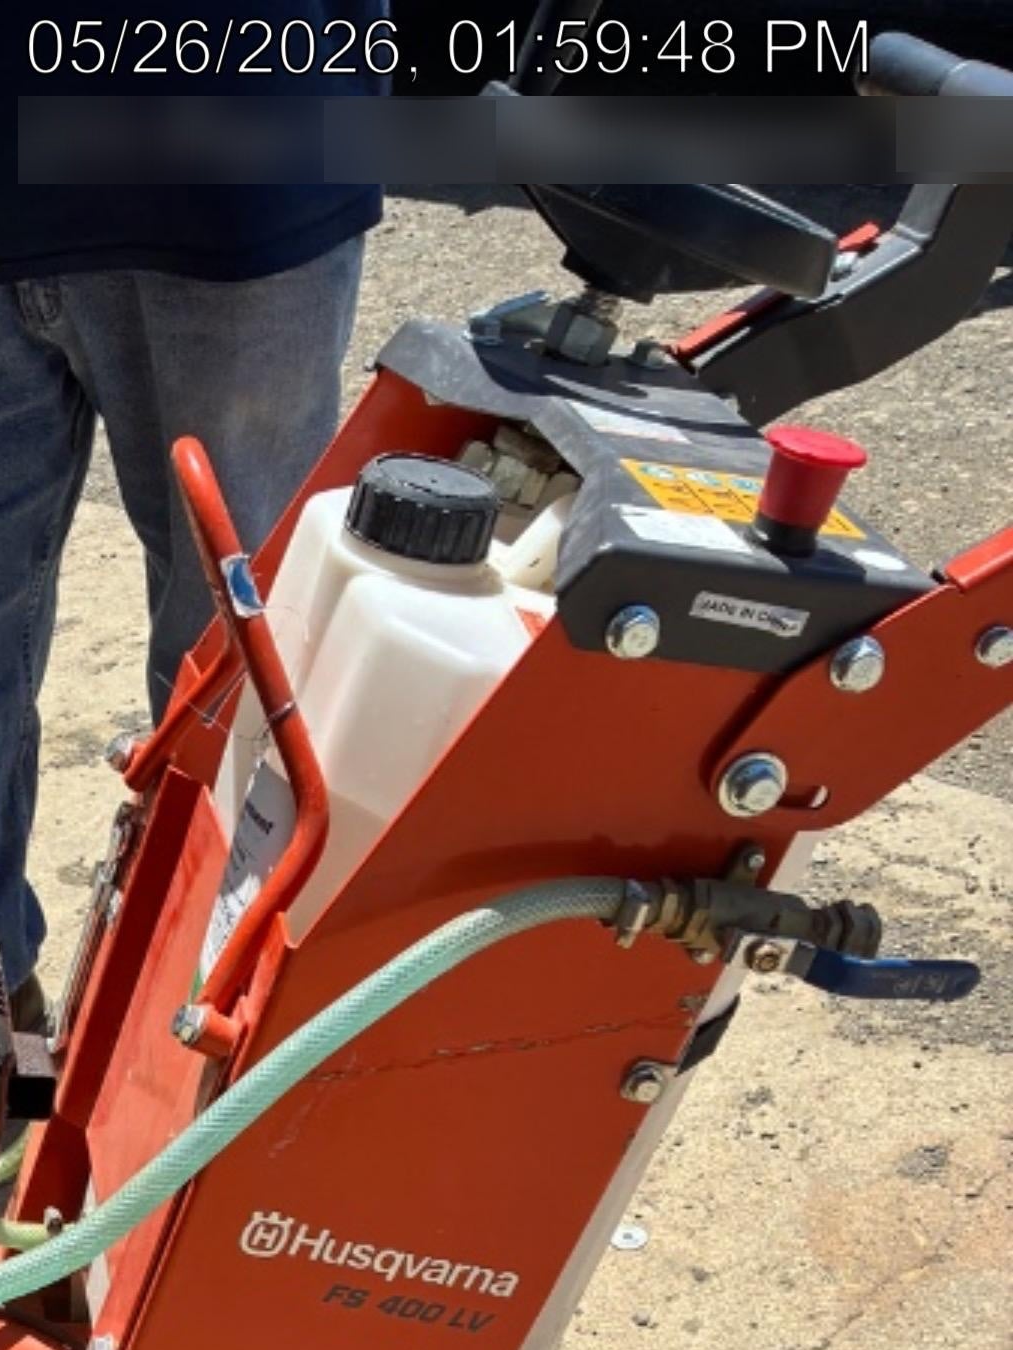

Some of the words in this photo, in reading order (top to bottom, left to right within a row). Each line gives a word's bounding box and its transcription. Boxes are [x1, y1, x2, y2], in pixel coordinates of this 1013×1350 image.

[740, 605, 756, 619] IN
[287, 1223, 520, 1298] Husqvarna
[321, 1283, 370, 1309] FS
[376, 1294, 446, 1324] 400
[447, 1306, 496, 1333] LV
